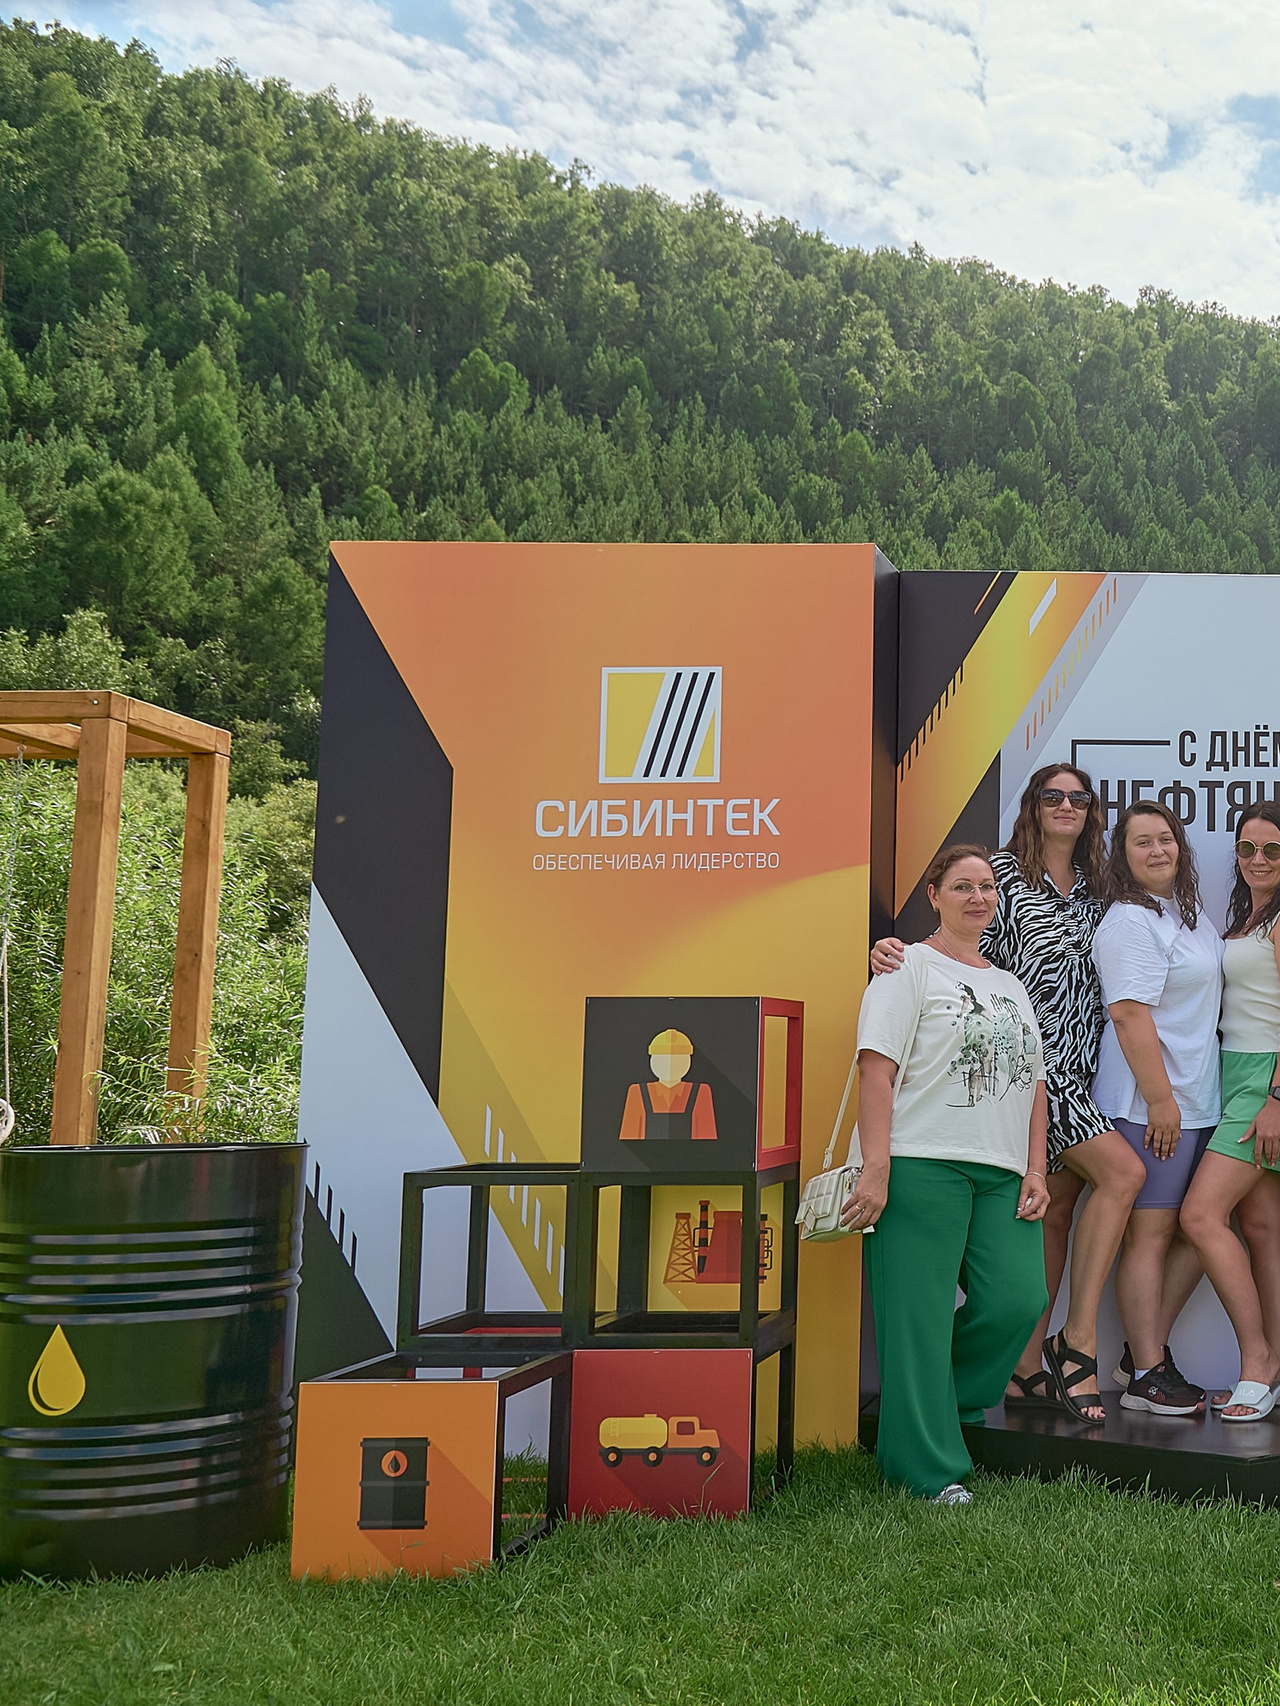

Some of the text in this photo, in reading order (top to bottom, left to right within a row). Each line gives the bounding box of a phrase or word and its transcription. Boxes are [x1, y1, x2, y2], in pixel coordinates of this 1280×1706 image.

[1178, 730, 1197, 768] С
[535, 798, 781, 838] СИБИНТЕК
[532, 852, 780, 872] ОБЕСПЕЧИВАЯ ЛИДЕРСТВО
